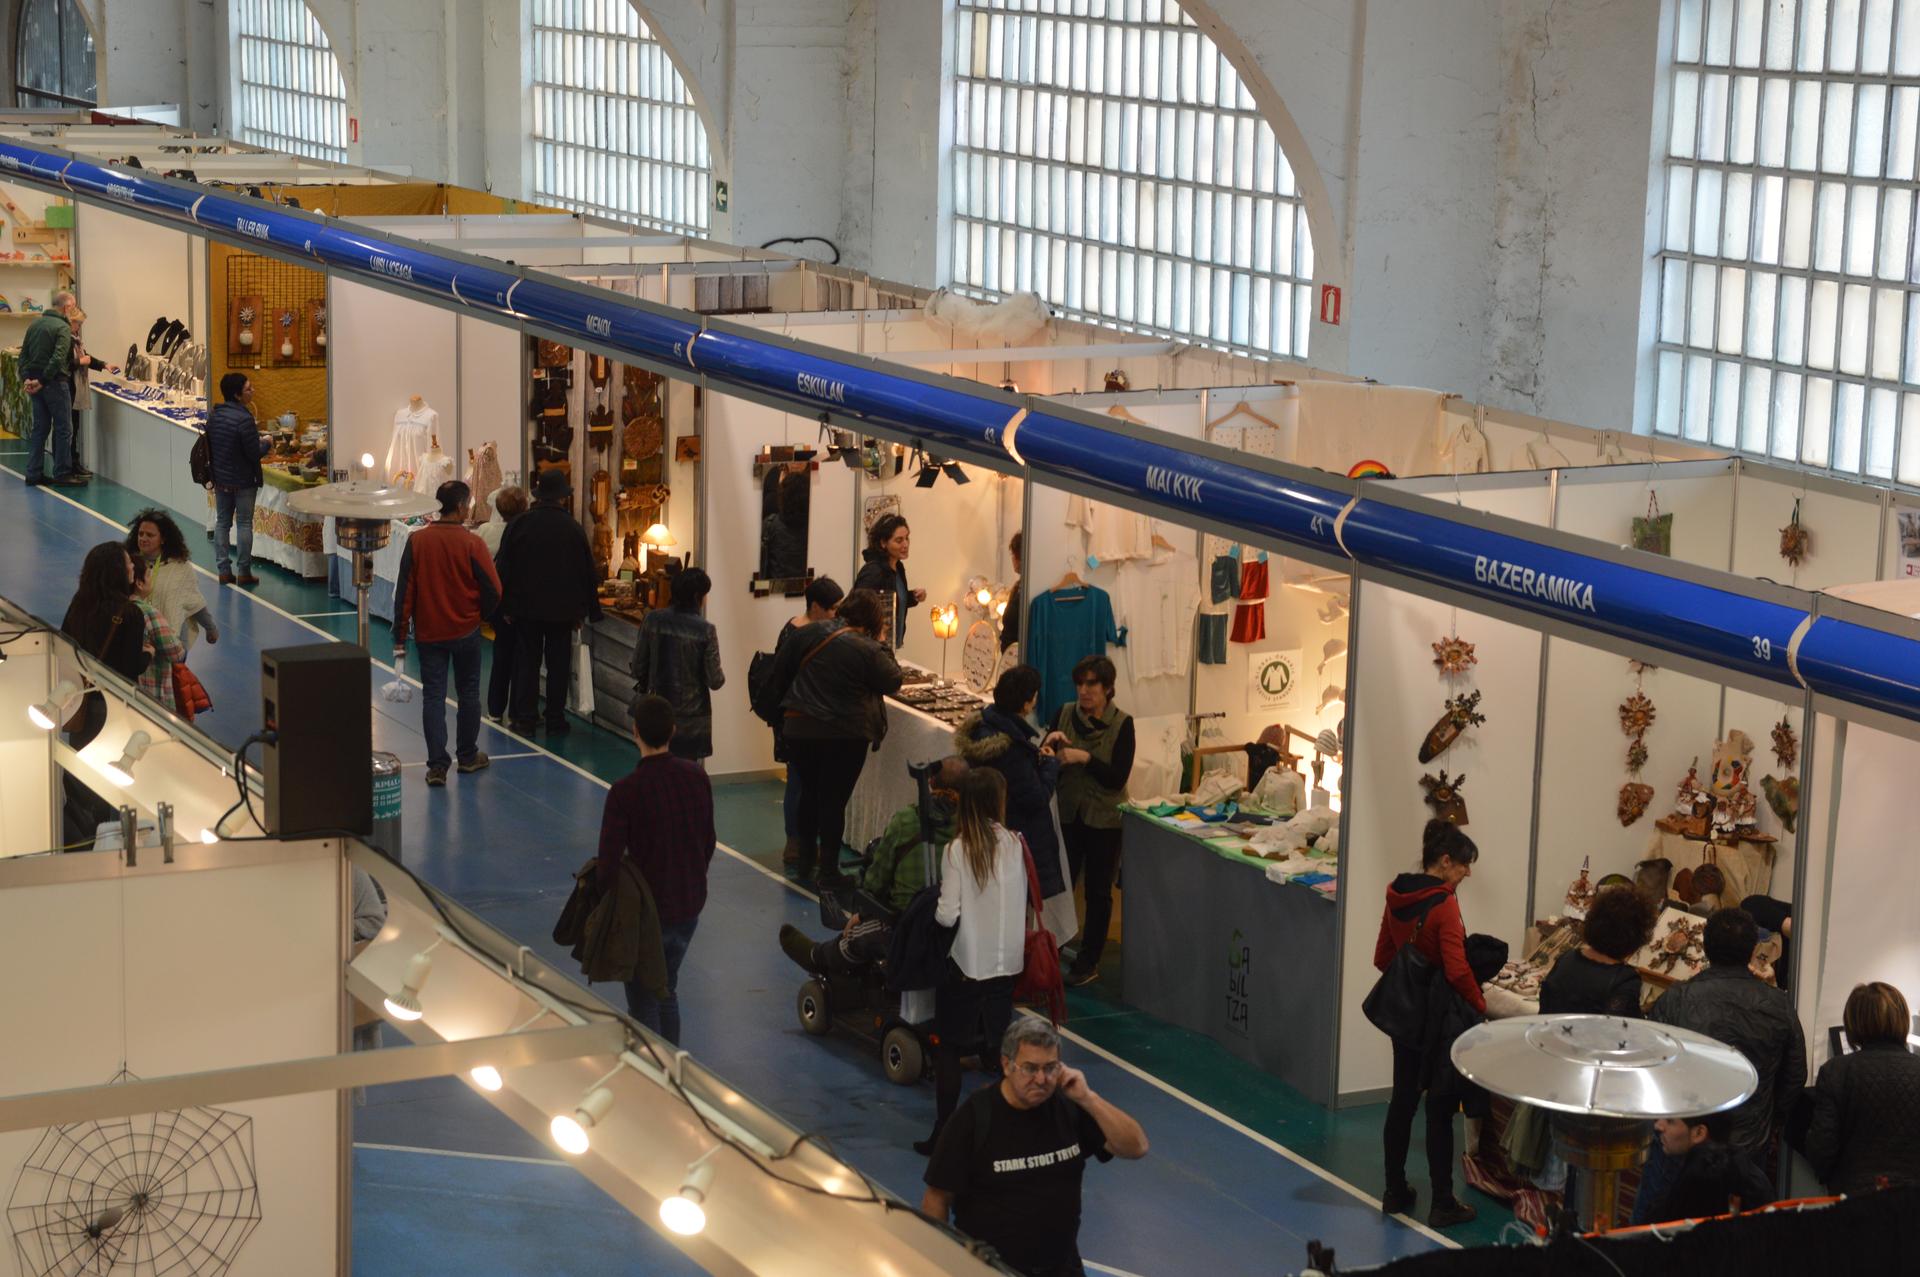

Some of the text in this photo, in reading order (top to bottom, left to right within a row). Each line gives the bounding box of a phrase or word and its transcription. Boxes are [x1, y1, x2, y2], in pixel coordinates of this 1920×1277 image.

[236, 217, 256, 238] TALLER
[673, 341, 682, 358] 45
[797, 371, 845, 404] ESKULAN
[984, 426, 996, 445] 43
[1310, 514, 1324, 537] 41
[1475, 555, 1596, 613] BAZERAMIKA
[1752, 635, 1771, 661] 39
[993, 1158, 1027, 1173] STARK
[1026, 1152, 1055, 1169] STOLT
